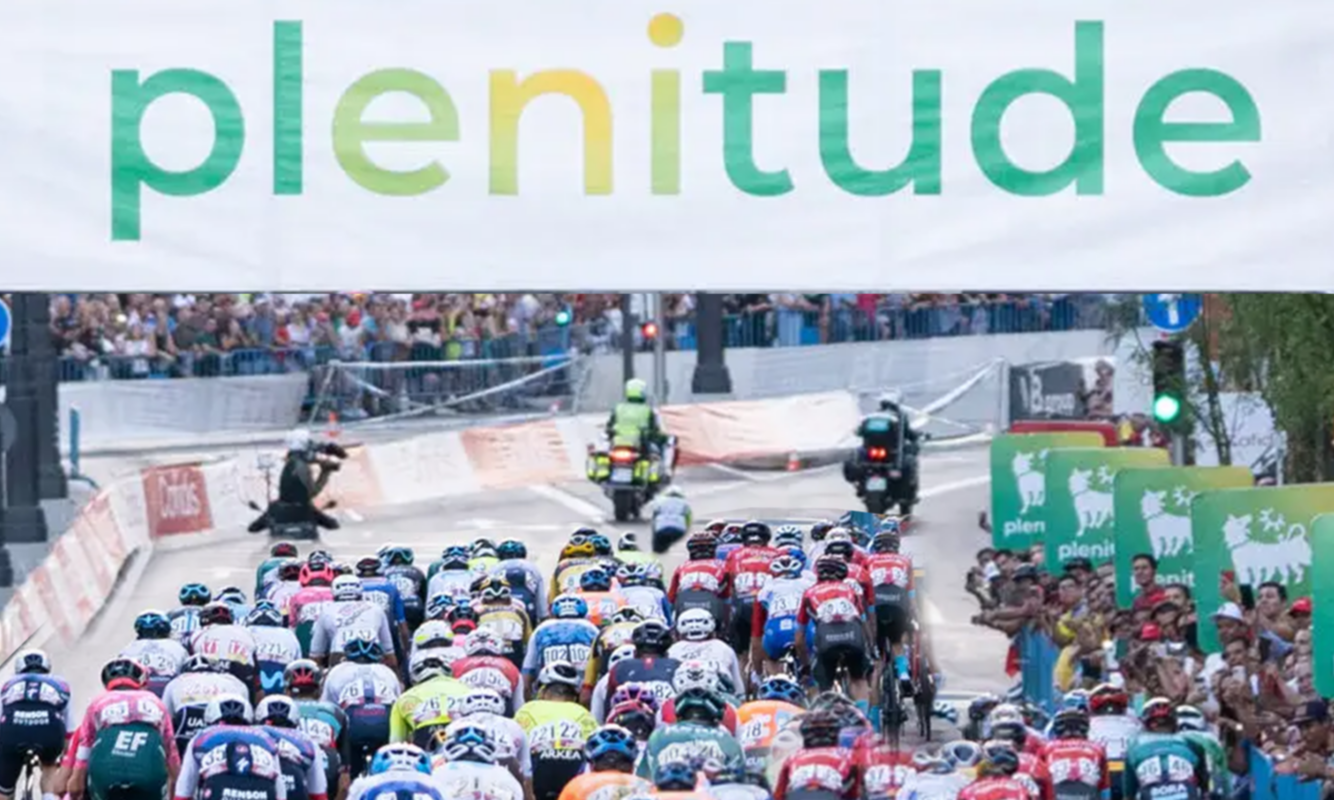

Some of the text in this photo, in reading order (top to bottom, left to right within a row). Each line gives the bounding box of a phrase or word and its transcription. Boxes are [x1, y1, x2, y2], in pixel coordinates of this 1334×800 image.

[111, 13, 1261, 241] plenitude
[115, 730, 148, 750] EF
[223, 787, 268, 799] RENSON
